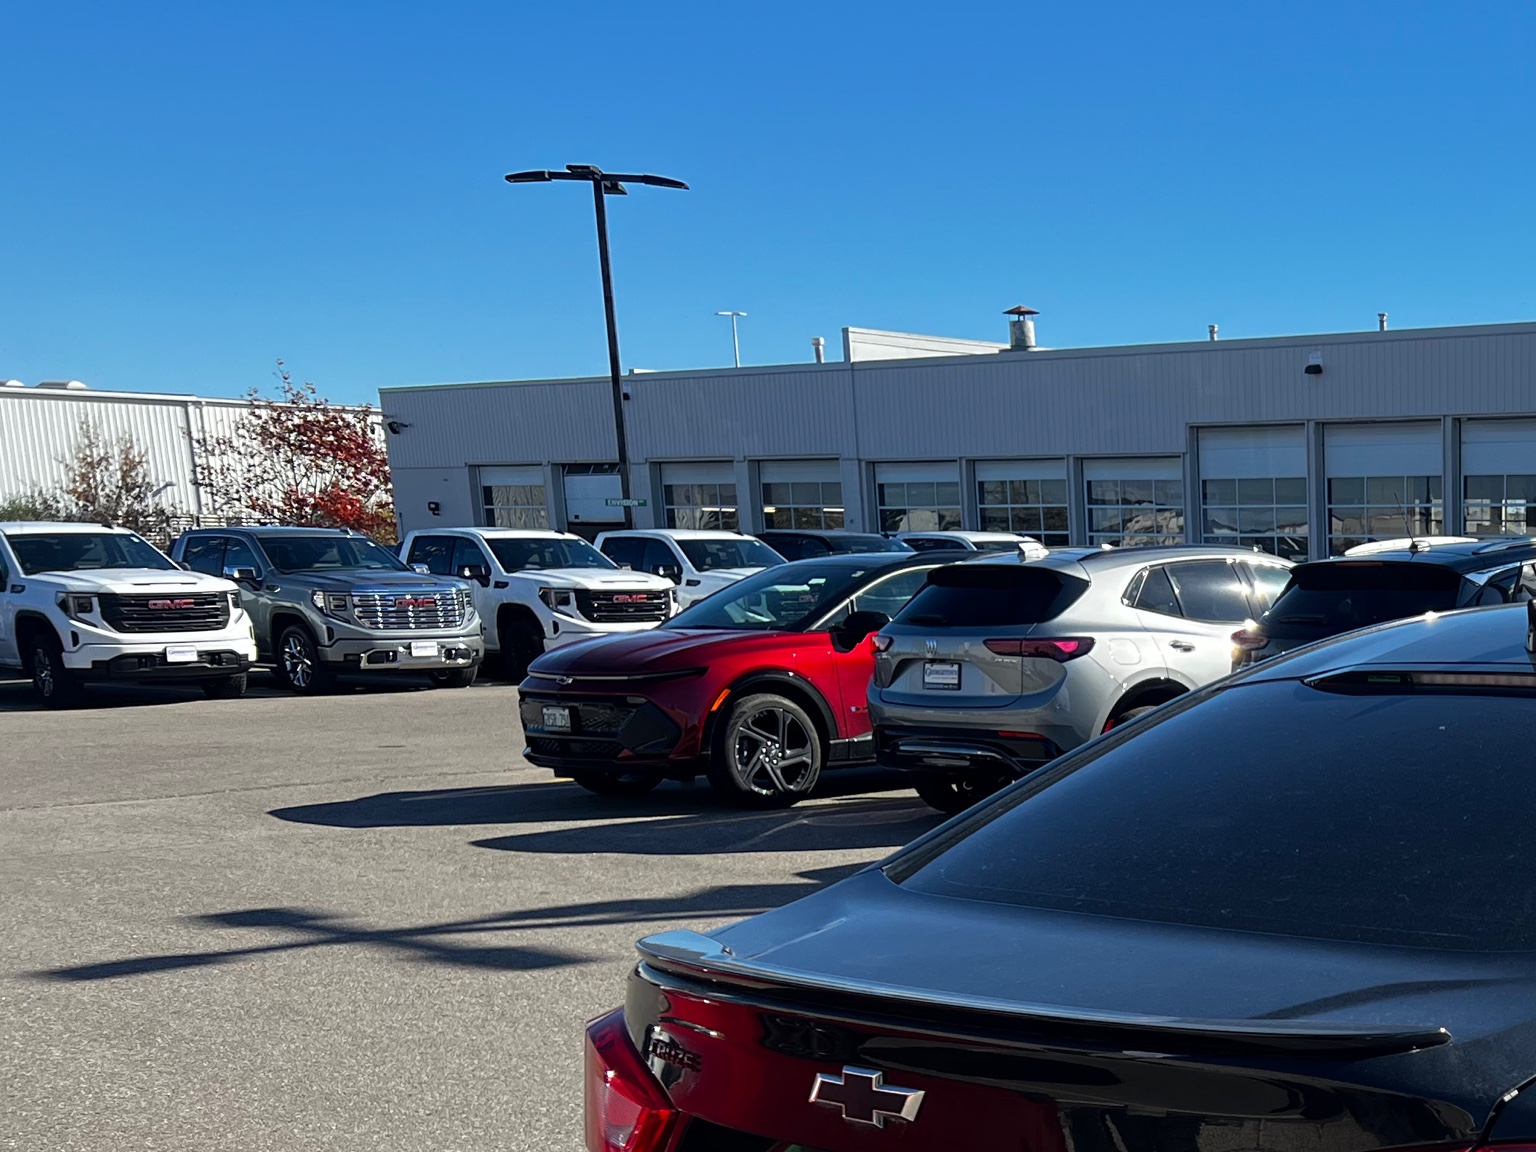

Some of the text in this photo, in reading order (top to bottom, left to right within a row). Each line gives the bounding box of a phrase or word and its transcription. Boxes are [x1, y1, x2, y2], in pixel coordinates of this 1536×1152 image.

[396, 598, 436, 608] GMC
[613, 594, 647, 603] GMC
[148, 599, 194, 609] GMC
